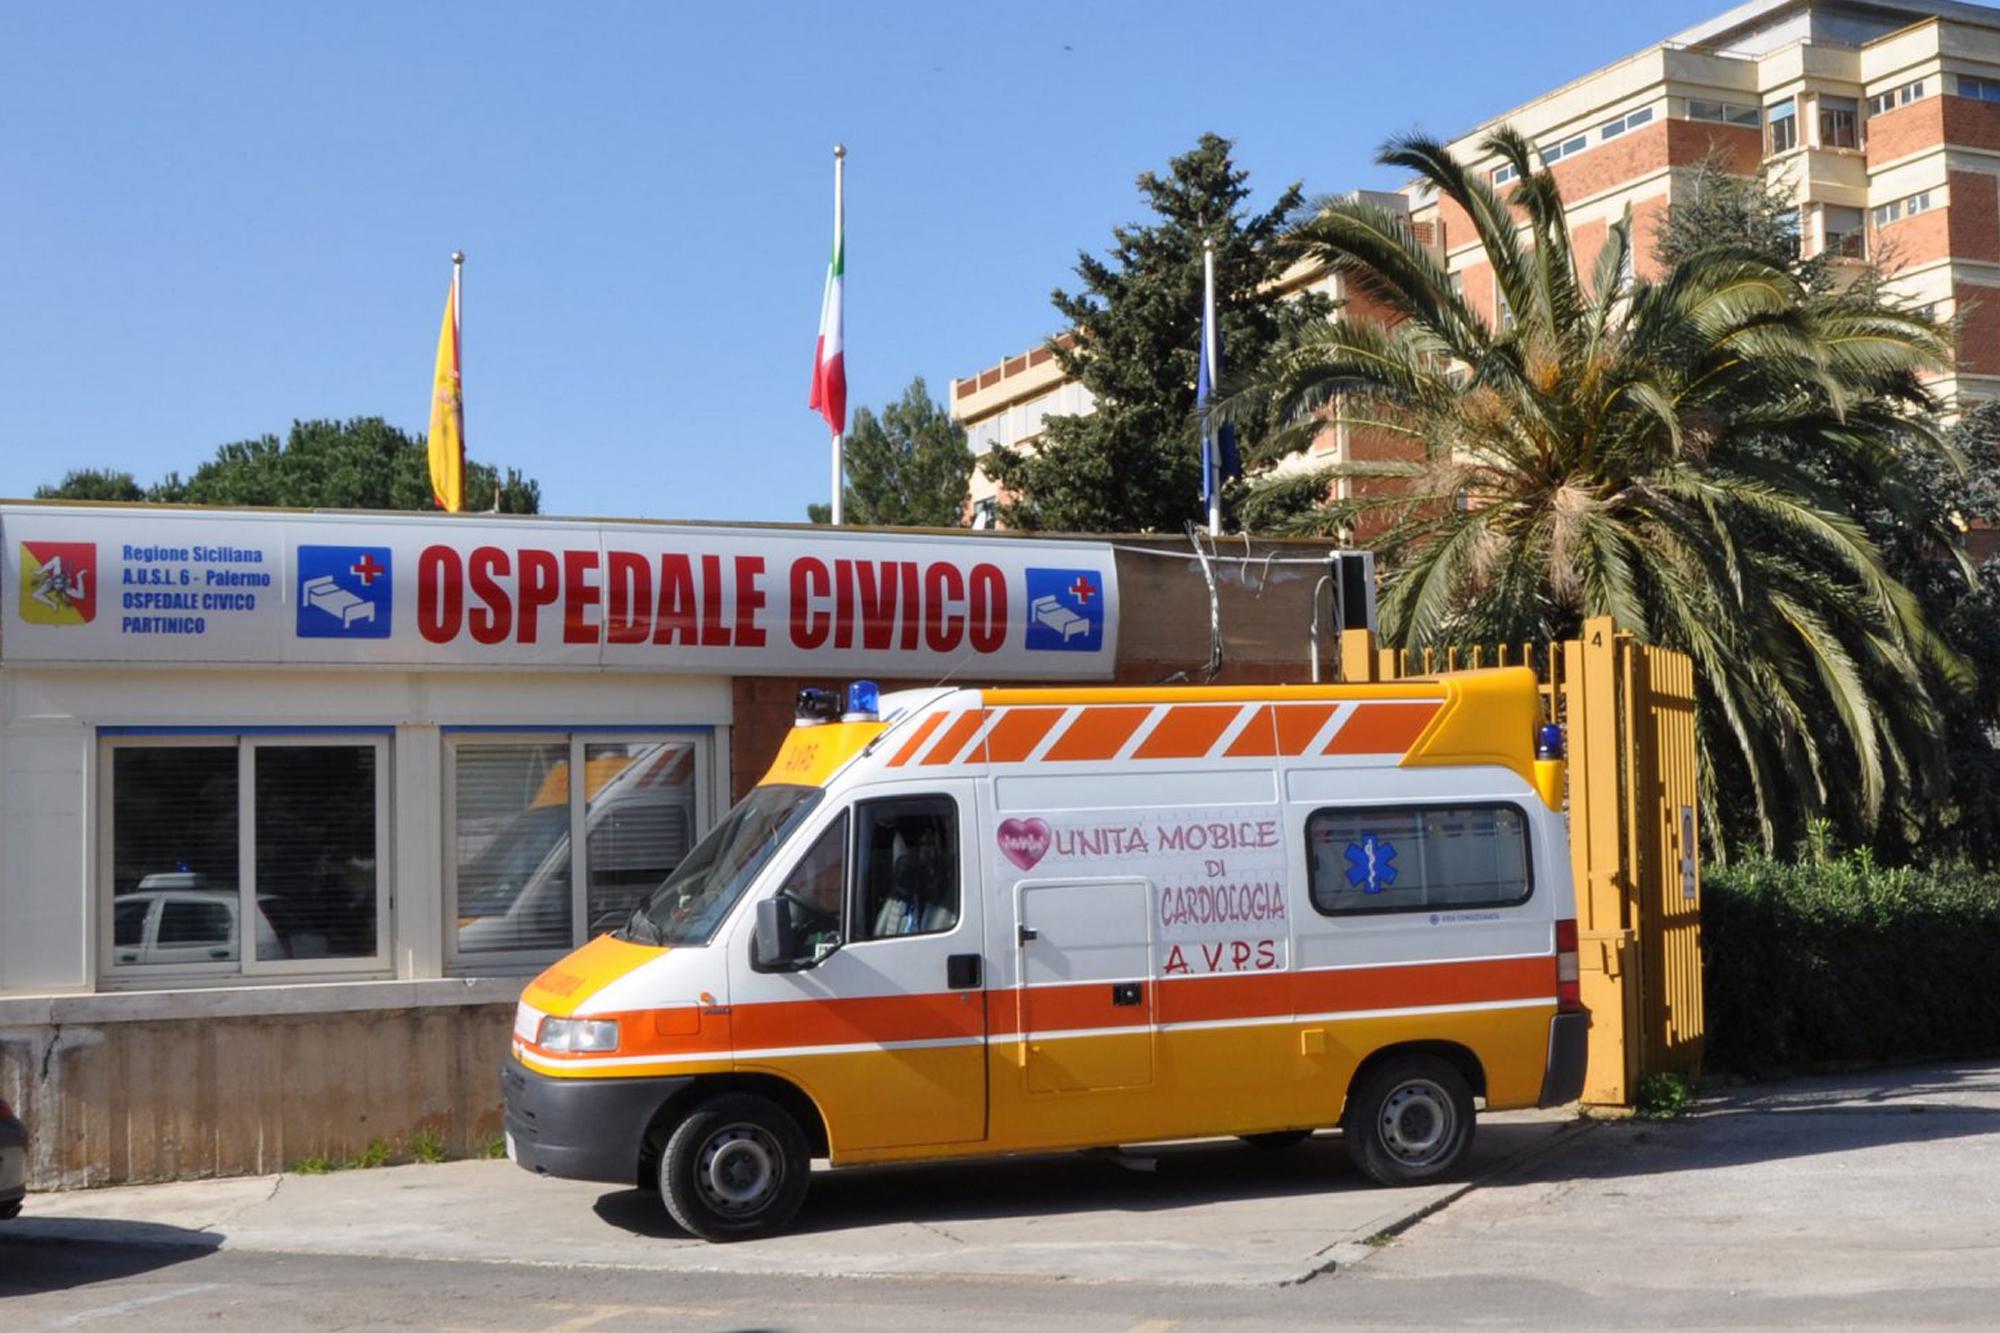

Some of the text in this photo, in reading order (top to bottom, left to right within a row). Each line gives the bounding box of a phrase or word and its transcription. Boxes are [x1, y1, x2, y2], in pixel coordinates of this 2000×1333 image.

[123, 545, 262, 563] Regione Siciliana
[180, 569, 190, 585] 6
[206, 570, 270, 587] Palermo
[123, 592, 255, 610] OSPEDALE CIVICO
[417, 544, 1008, 654] OSPEDALE CIVICO
[122, 617, 205, 633] PARTINICO
[1591, 631, 1602, 648] 4
[1157, 821, 1280, 851] MOBILE
[1205, 859, 1226, 877] DI
[1161, 882, 1285, 926] CARDIOLOGIA
